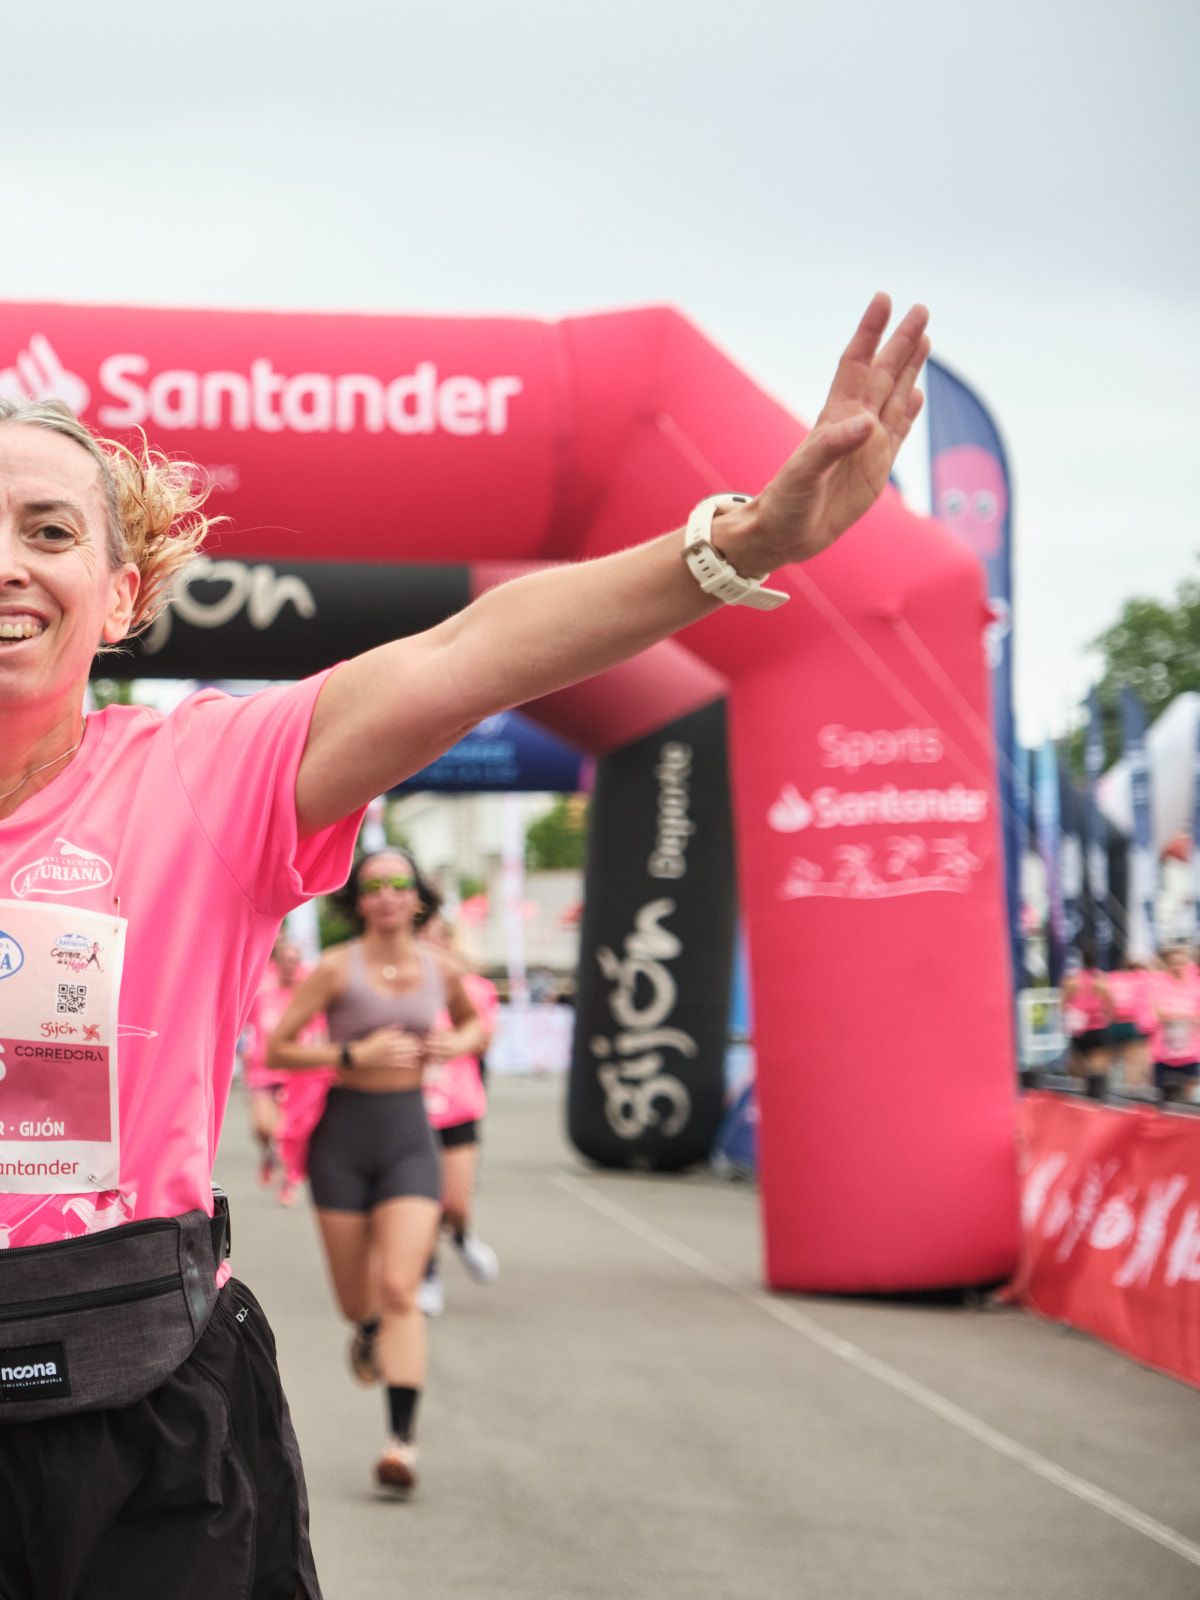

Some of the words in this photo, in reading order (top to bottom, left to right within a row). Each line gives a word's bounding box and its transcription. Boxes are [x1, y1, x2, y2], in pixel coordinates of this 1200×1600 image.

[97, 352, 524, 437] Santander
[41, 1021, 78, 1038] gijón
[14, 1045, 103, 1062] CORREDORA
[19, 1117, 65, 1137] GIJÓN
[1, 1361, 57, 1381] noona
